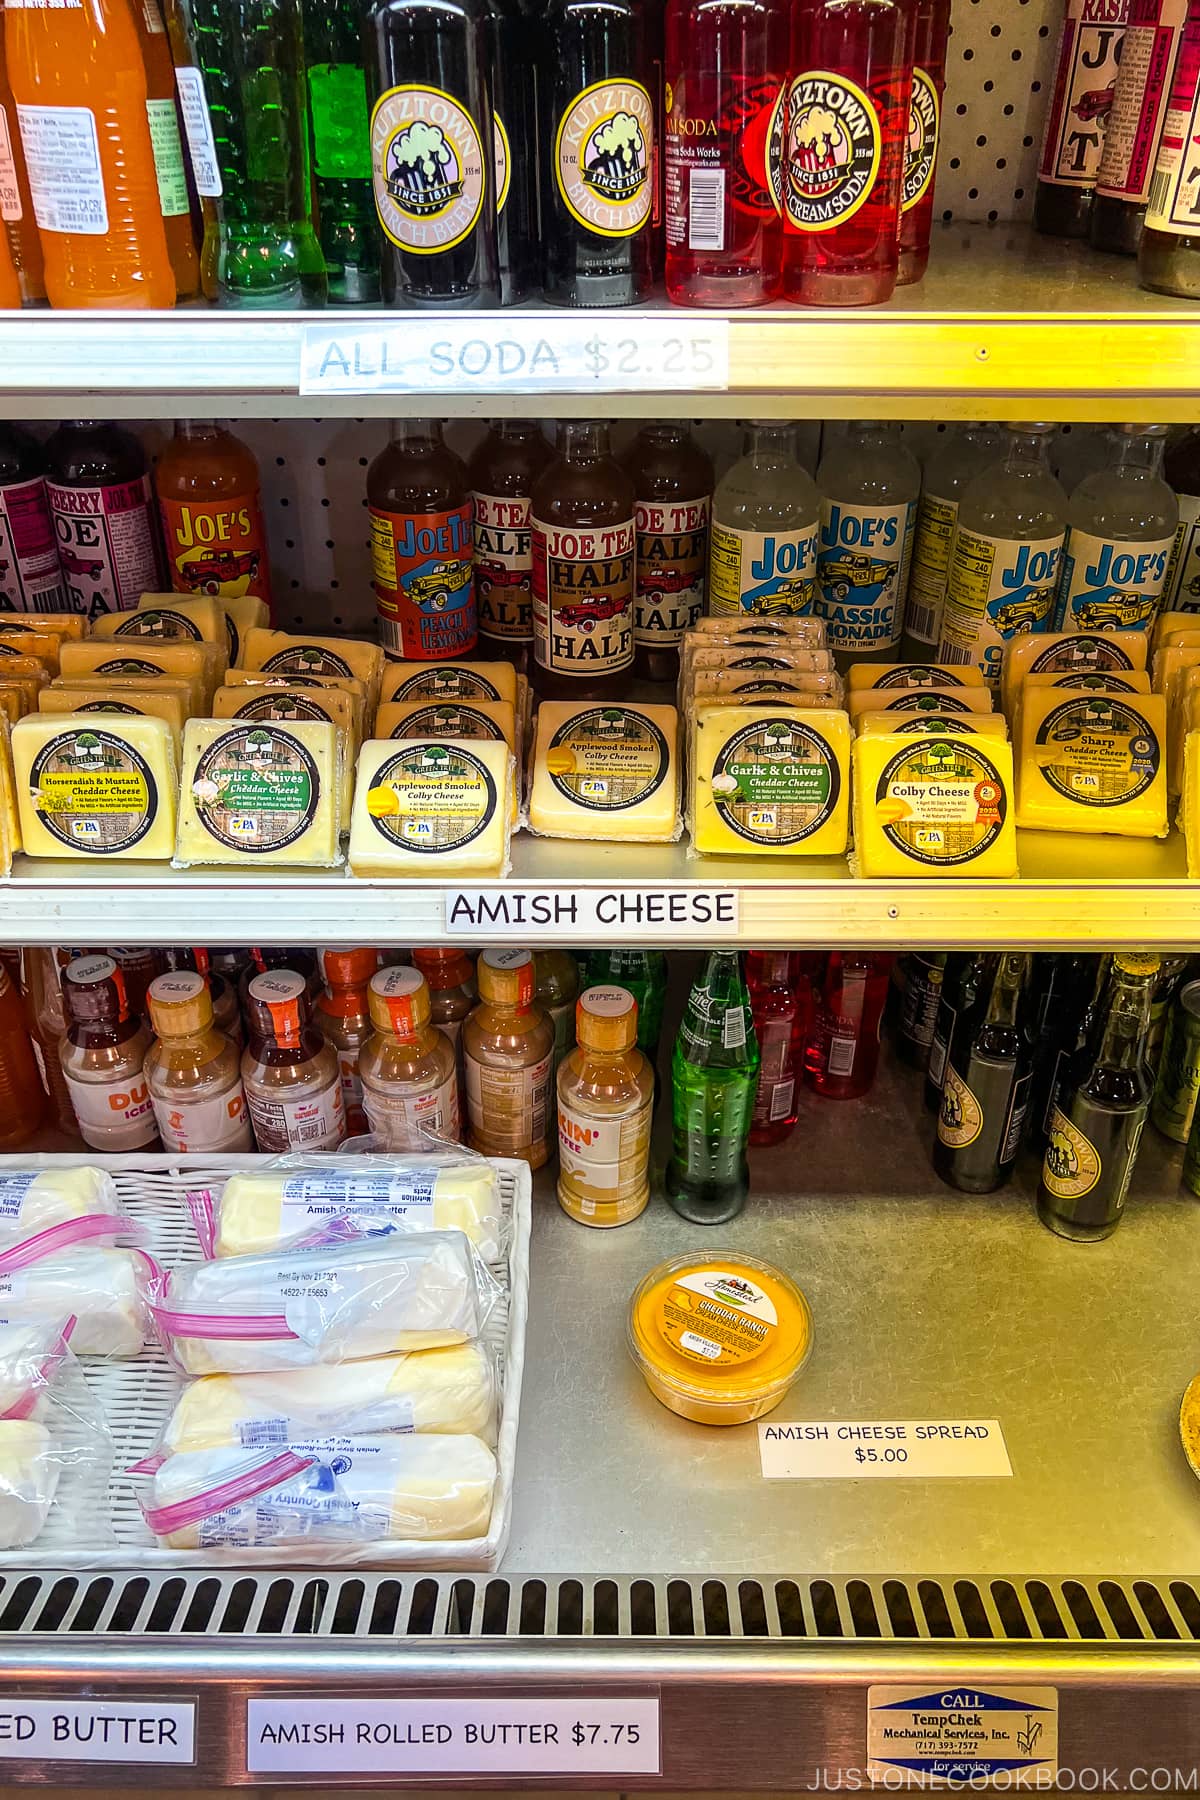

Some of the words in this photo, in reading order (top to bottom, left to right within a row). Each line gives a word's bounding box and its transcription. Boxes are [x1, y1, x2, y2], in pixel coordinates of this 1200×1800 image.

[774, 80, 871, 141] KUTZTOWN
[373, 94, 477, 159] KUTZTOWN
[679, 119, 719, 136] SODA
[680, 147, 696, 158] Soda
[696, 147, 721, 159] Works
[591, 172, 623, 189] SINCE
[791, 167, 815, 184] SINCE
[906, 155, 932, 196] SODA
[392, 186, 425, 203] SINCE
[790, 196, 834, 224] CREAM
[832, 170, 869, 212] SODA
[568, 183, 623, 226] BIRCH
[379, 194, 428, 244] BIRCH
[434, 196, 476, 244] BEER
[319, 341, 404, 377] ALL
[429, 339, 560, 375] SODA
[584, 334, 715, 379] $2.25
[671, 503, 708, 532] TEA
[55, 515, 100, 547] OE
[176, 507, 251, 546] JOE'S
[820, 506, 898, 547] JOE'S
[937, 526, 950, 535] 240
[548, 531, 595, 559] JOE
[601, 527, 635, 557] TEA
[726, 555, 738, 565] 240
[1085, 544, 1168, 587] JOE'S
[551, 557, 631, 588] HALF
[974, 562, 988, 573] 240
[554, 588, 577, 596] LEMON
[579, 588, 592, 596] TEA
[72, 584, 112, 617] EA
[420, 613, 463, 632] PEACH
[553, 629, 632, 660] HALF
[570, 742, 618, 752] Applewood
[619, 743, 654, 752] Smoked
[1080, 736, 1115, 748] Sharp
[584, 752, 608, 761] Colby
[609, 752, 638, 761] Cheese
[1063, 745, 1098, 755] Cheddar
[1099, 748, 1129, 757] Cheese
[211, 770, 248, 783] Garlic
[249, 771, 261, 783] &
[263, 770, 304, 783] Chives
[731, 765, 767, 776] Garlic
[769, 765, 780, 776] &
[783, 765, 823, 776] Chives
[45, 777, 95, 786] Horseradish
[105, 777, 140, 786] Mustard
[391, 782, 443, 791] Applewood
[444, 781, 481, 790] Smoked
[593, 782, 606, 791] PA
[749, 778, 787, 787] Cheddar
[788, 778, 819, 787] Cheese
[1084, 775, 1097, 785] PA
[72, 786, 109, 796] Cheddar
[110, 786, 141, 795] Cheese
[230, 783, 268, 794] Cheddar
[269, 784, 300, 794] Cheese
[892, 786, 926, 799] Colby
[928, 786, 971, 797] Cheese
[407, 792, 433, 801] Colby
[433, 792, 464, 800] Cheese
[979, 807, 998, 815] 2020
[242, 819, 255, 830] PA
[761, 813, 774, 823] PA
[84, 822, 98, 832] PA
[418, 823, 431, 833] PA
[929, 832, 941, 842] PA
[450, 894, 578, 924] AMISH
[595, 893, 735, 924] CHEESE
[271, 1119, 286, 1128] 280
[559, 1132, 582, 1154] FFEE
[401, 1193, 432, 1203] Nutrition
[413, 1188, 432, 1196] Facts
[306, 1205, 337, 1216] Amish
[704, 1279, 765, 1305] Homestead
[695, 1307, 717, 1324] CREAM
[715, 1315, 739, 1332] CHEESE
[738, 1325, 765, 1342] SPREAD
[698, 1300, 739, 1323] CHEDDAR
[738, 1317, 769, 1336] RANCH
[765, 1426, 829, 1441] AMISH
[837, 1426, 907, 1441] CHEESE
[916, 1425, 989, 1440] SPREAD
[854, 1446, 908, 1464] $5.00
[940, 1694, 985, 1708] CALL
[911, 1713, 983, 1728] TempChek
[52, 1715, 178, 1746] BUTTER
[260, 1722, 345, 1744] AMISH
[356, 1723, 453, 1744] ROLLED
[464, 1723, 559, 1744] BUTTER
[571, 1721, 641, 1747] $7.75
[883, 1728, 942, 1740] Mechanical
[943, 1728, 988, 1741] Services,
[992, 1729, 1010, 1740] Inc.
[914, 1741, 936, 1751] (717)
[938, 1741, 979, 1750] 393-7572
[933, 1759, 952, 1772] for
[952, 1760, 991, 1772] service
